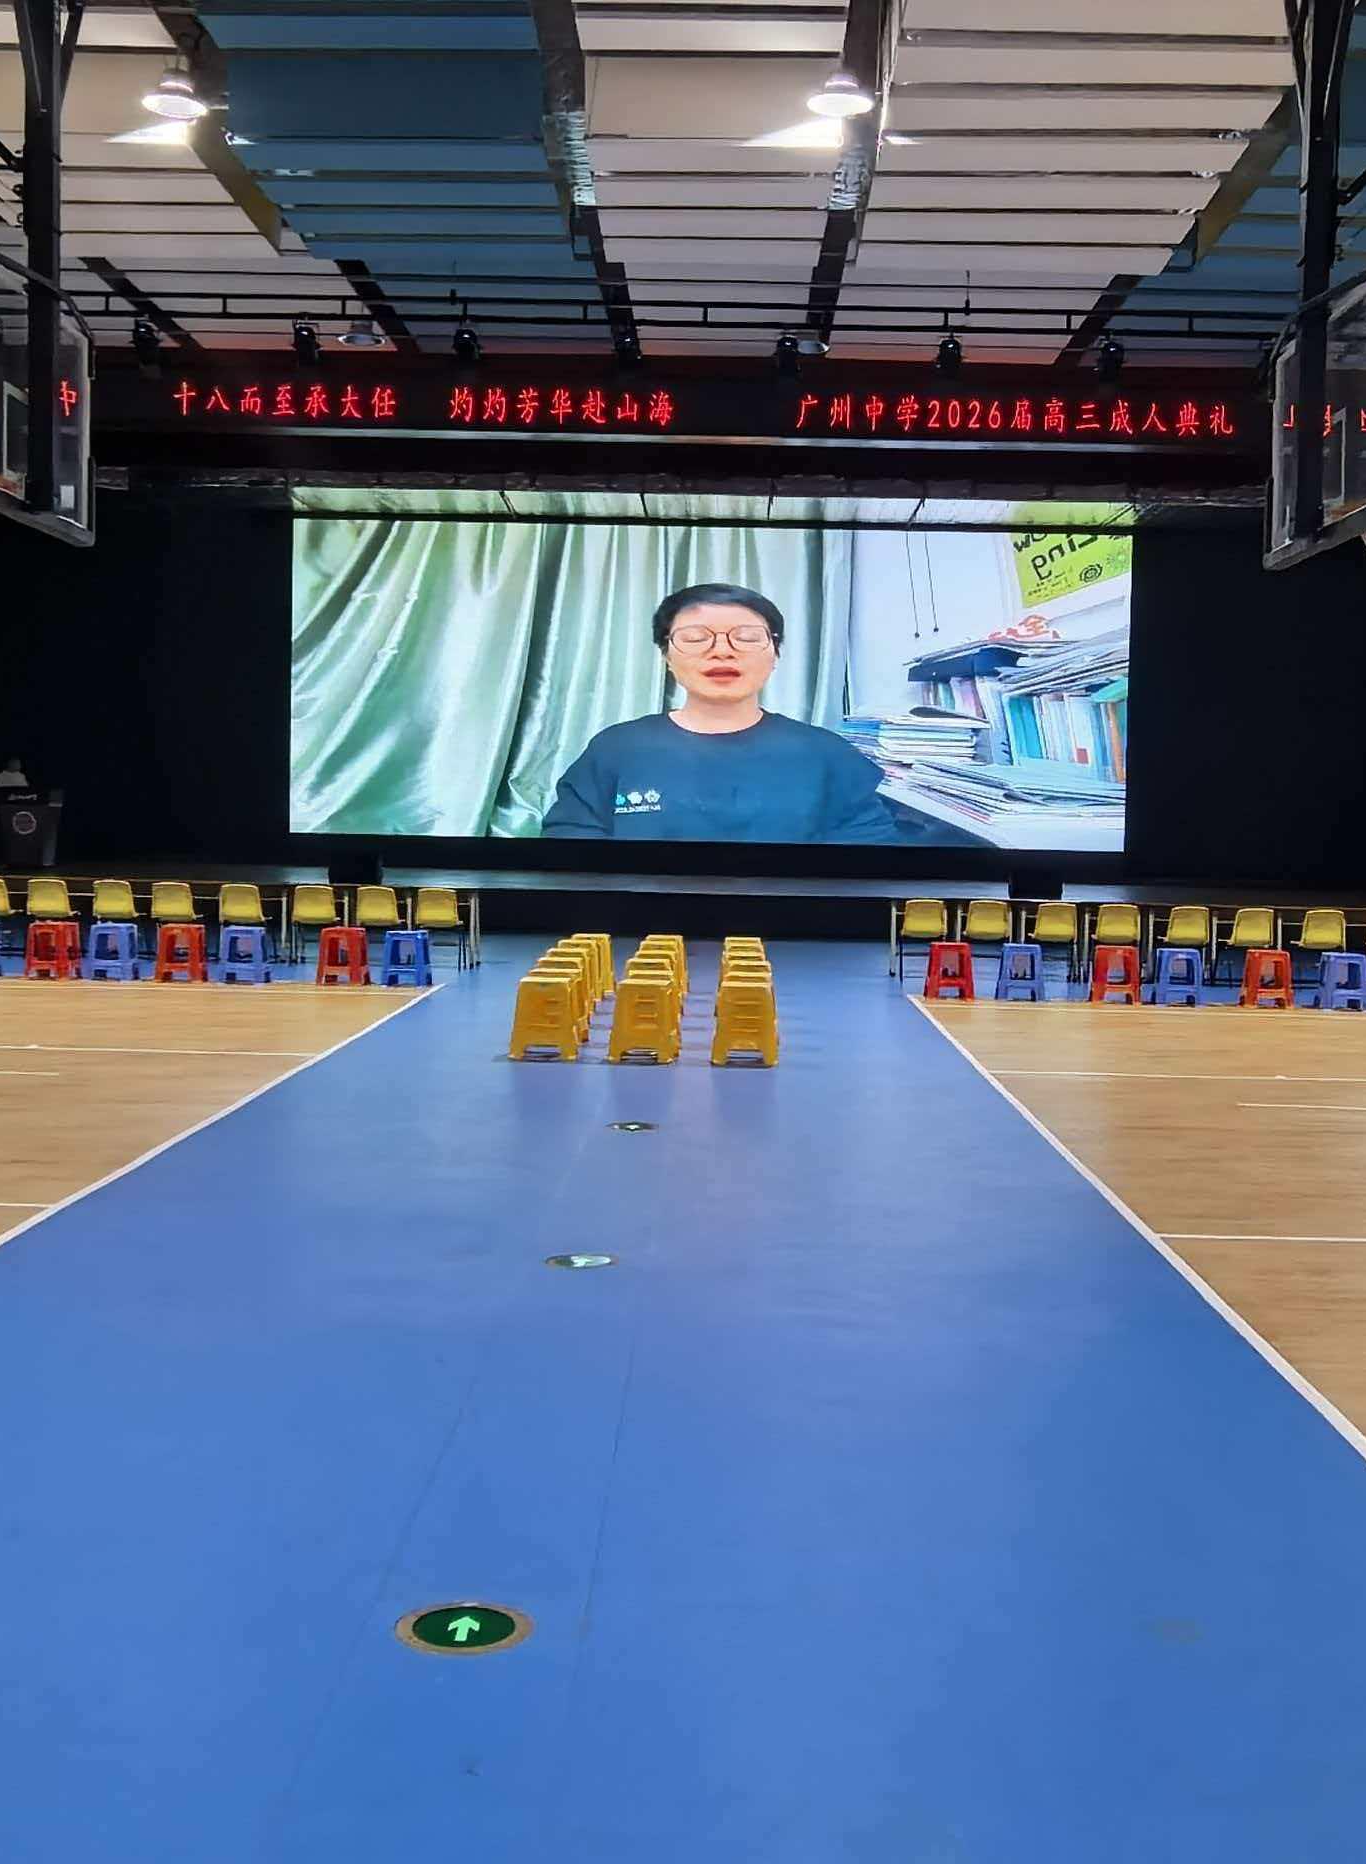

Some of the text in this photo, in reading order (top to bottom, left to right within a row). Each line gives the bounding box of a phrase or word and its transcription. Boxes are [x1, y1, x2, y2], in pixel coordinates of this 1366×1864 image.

[174, 380, 1235, 437] 十八而至承大任 灼灼芳华赴山海 广州中学2026届高三成人典礼
